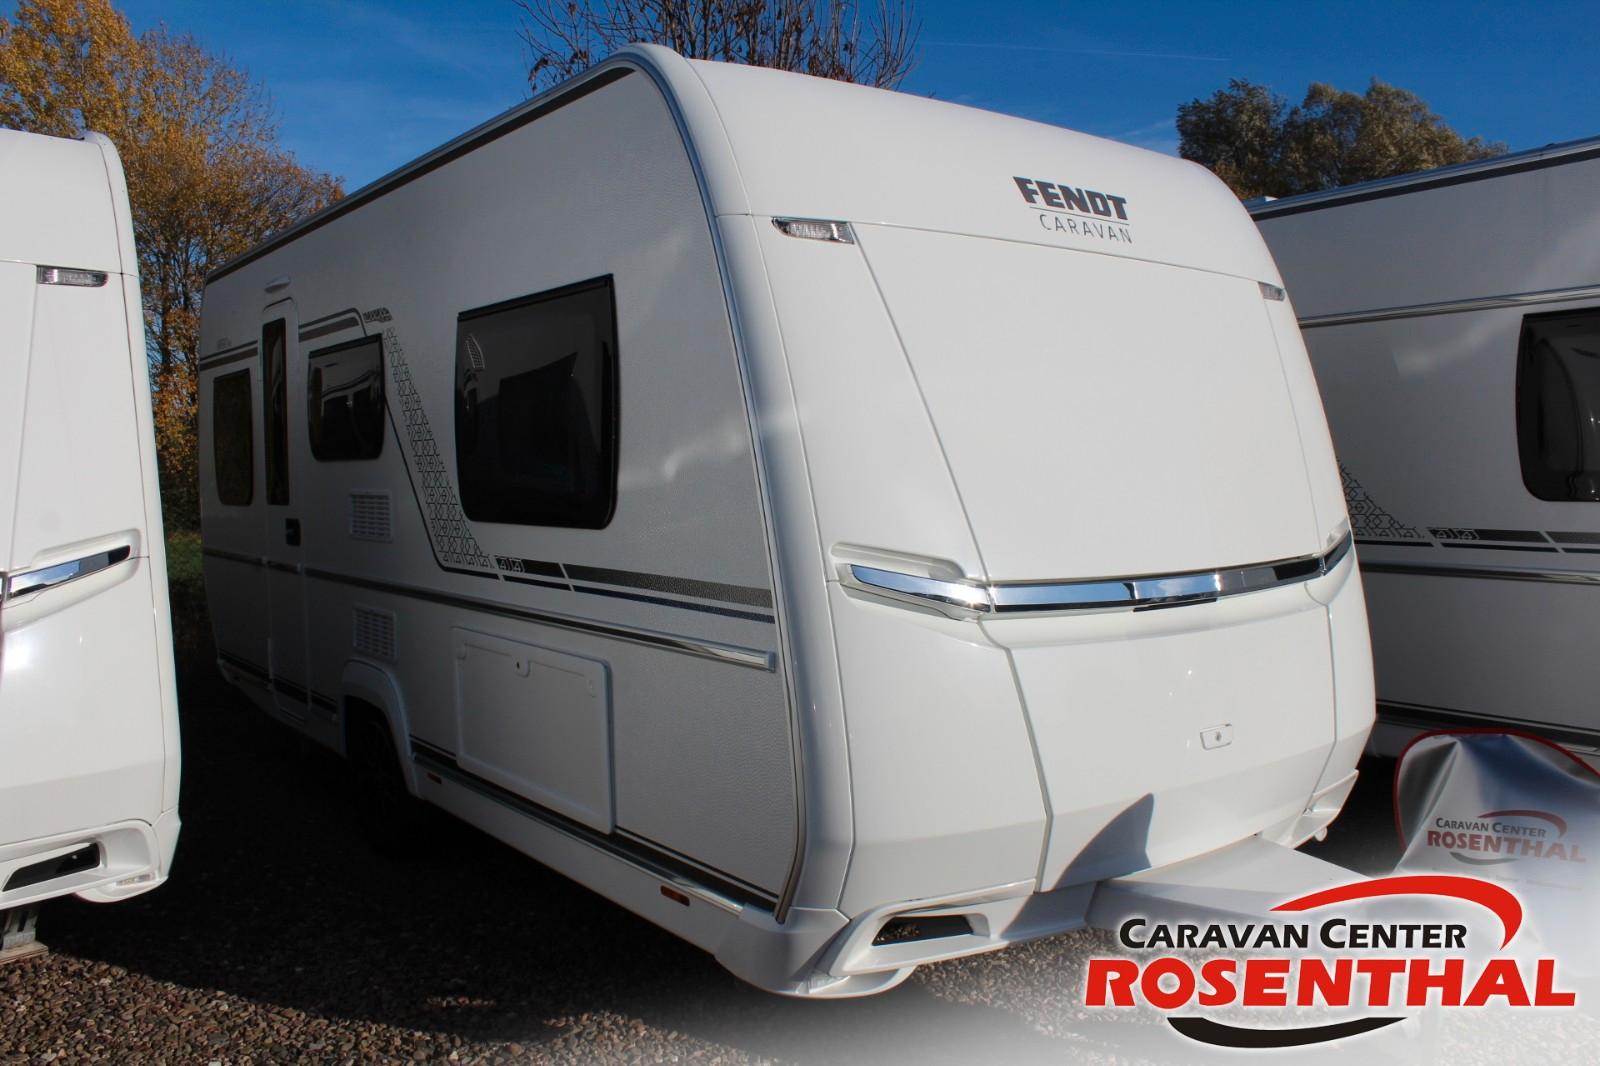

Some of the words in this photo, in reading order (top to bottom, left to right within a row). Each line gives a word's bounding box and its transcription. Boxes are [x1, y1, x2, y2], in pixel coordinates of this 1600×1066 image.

[1013, 176, 1128, 220] FENDT
[1040, 214, 1133, 244] CARAVAN
[1436, 818, 1489, 832] CARAVAN
[1492, 822, 1547, 838] CENTER
[1427, 831, 1587, 863] ROSENTHAL
